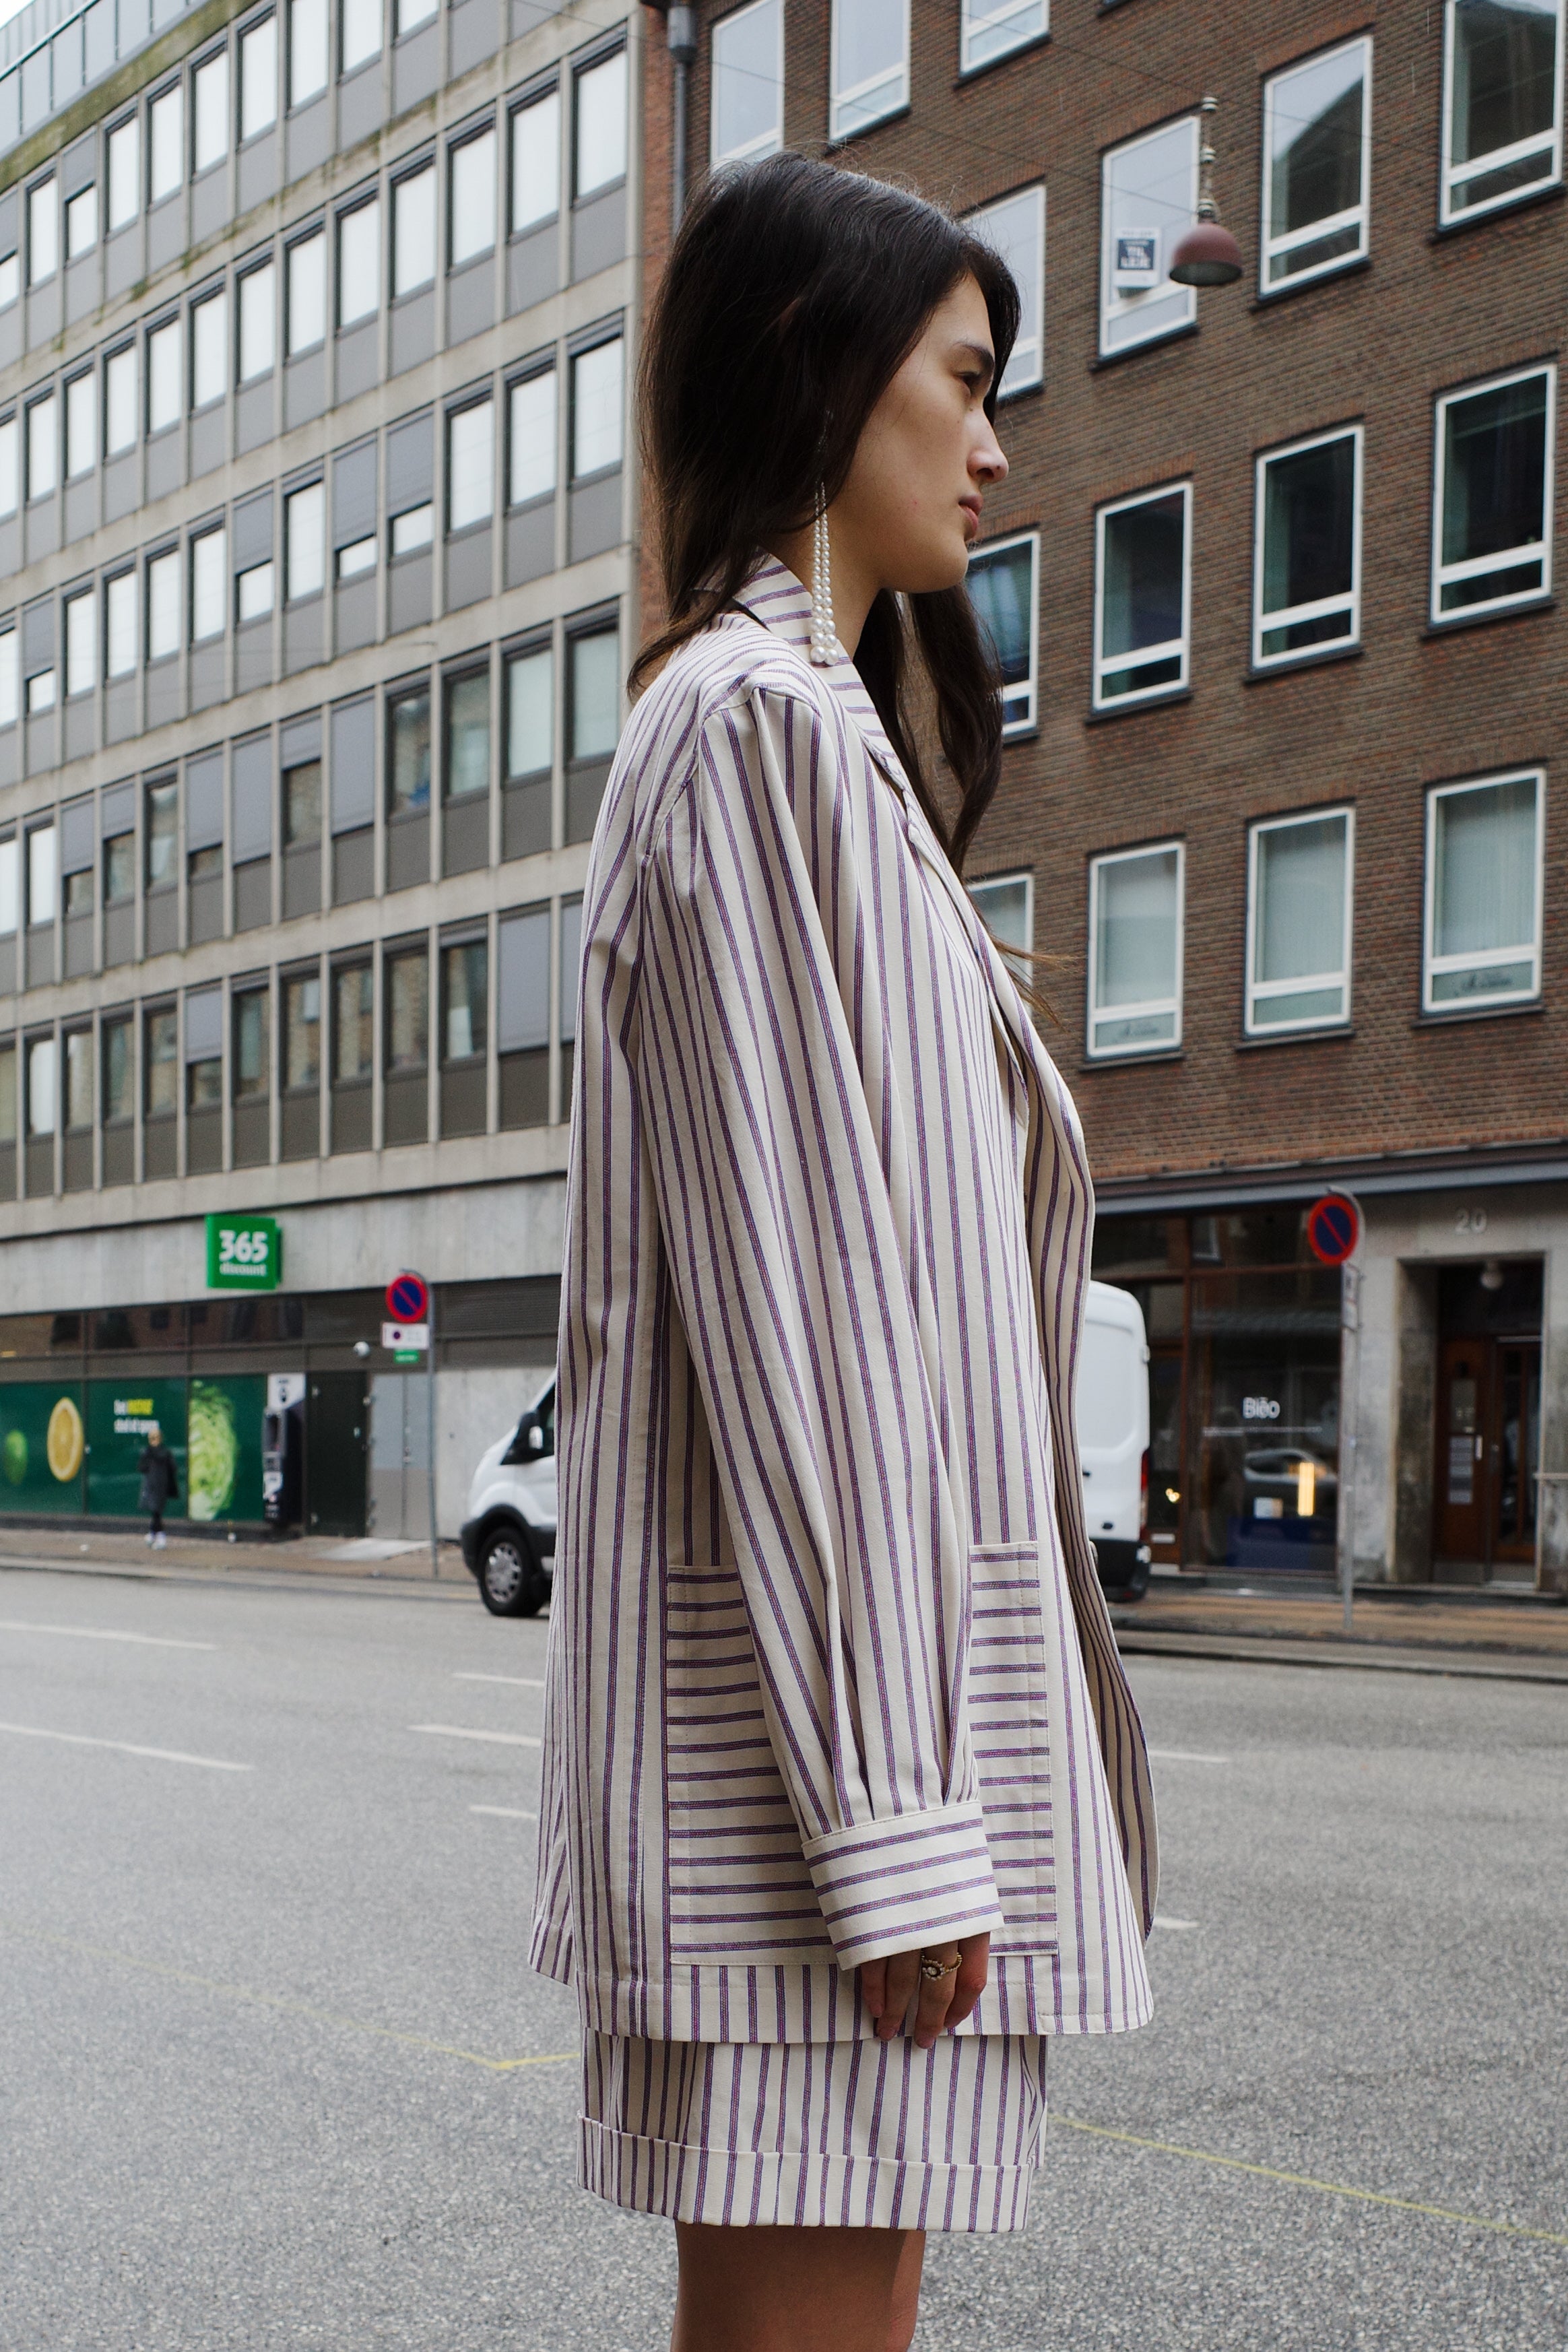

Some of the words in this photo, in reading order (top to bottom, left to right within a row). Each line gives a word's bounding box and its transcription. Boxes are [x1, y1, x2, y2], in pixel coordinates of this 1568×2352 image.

[1454, 1207, 1487, 1235] 20
[219, 1229, 268, 1263] 365
[220, 1262, 267, 1277] discount
